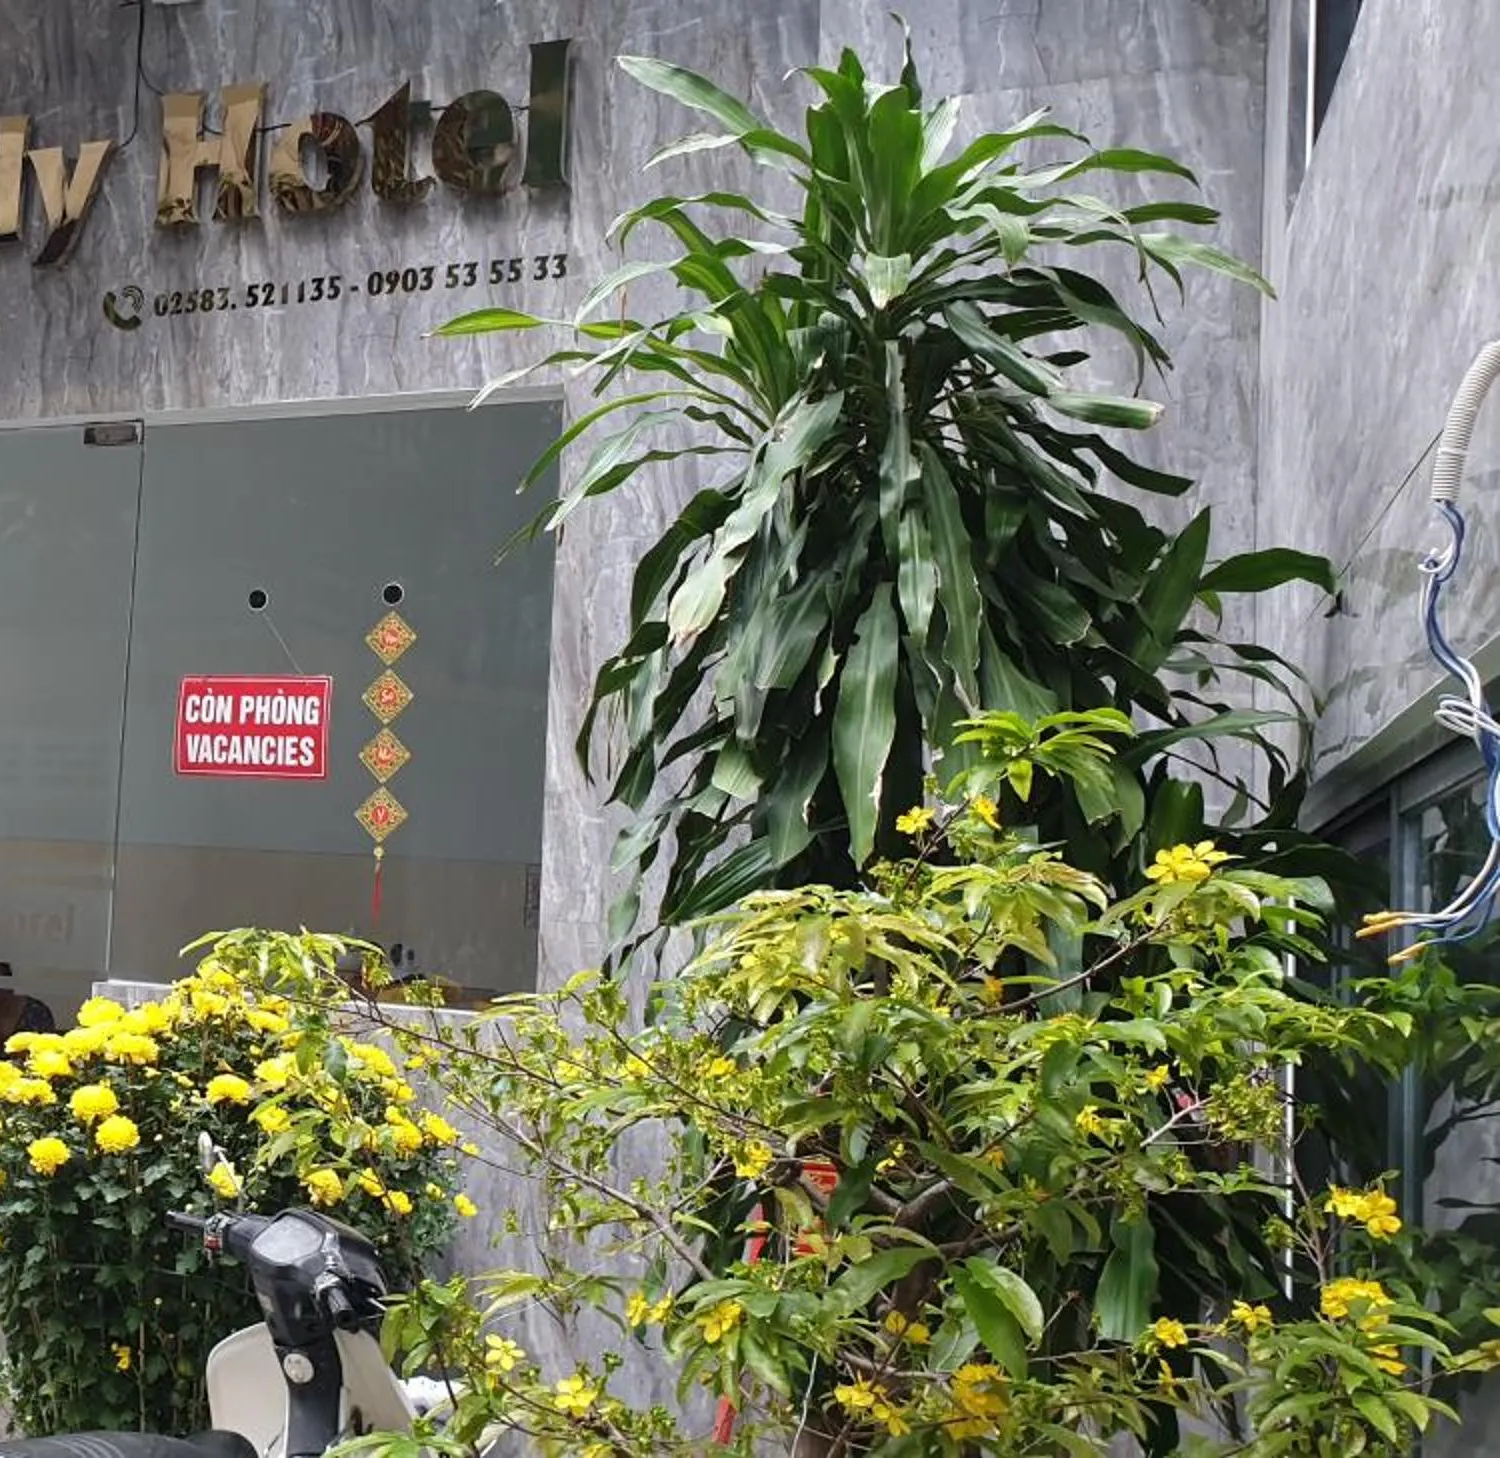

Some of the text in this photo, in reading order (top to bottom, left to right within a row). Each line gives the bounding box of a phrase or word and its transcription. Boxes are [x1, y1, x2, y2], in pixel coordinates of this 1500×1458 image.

[155, 38, 573, 226] Hotel
[154, 287, 237, 317] 02583.
[367, 266, 435, 296] 0903
[445, 261, 478, 290] 53
[489, 258, 522, 285] 55
[533, 253, 568, 281] 33
[185, 688, 320, 725] CÒN PHÒNG
[186, 733, 315, 767] VACANCIES
